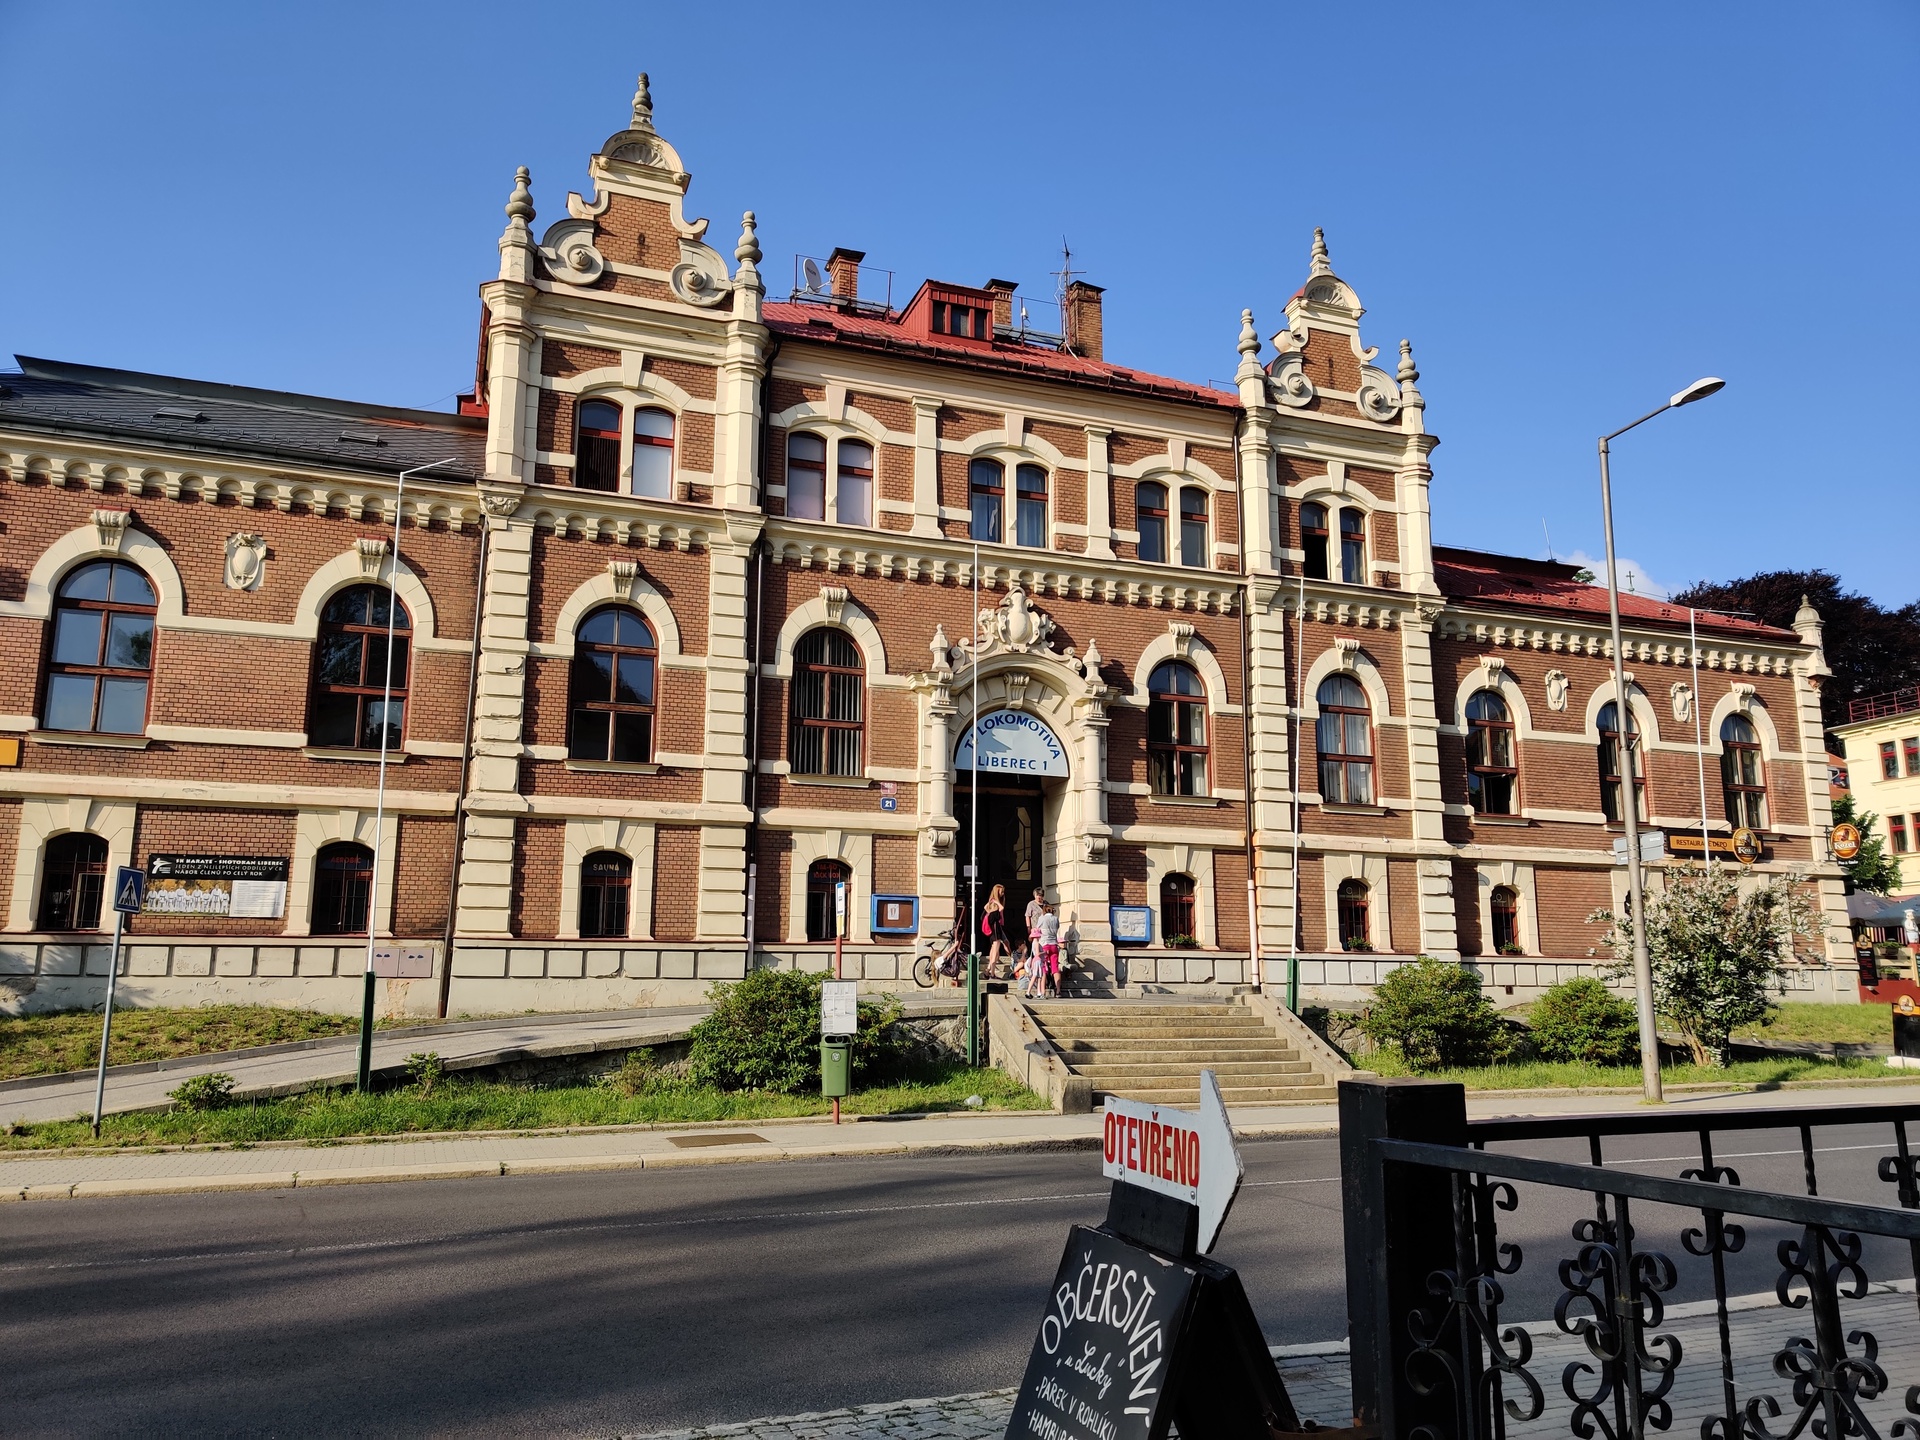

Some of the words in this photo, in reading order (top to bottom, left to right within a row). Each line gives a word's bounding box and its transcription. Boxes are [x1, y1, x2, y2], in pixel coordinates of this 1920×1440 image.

[976, 713, 1061, 760] LOKOMOTIVA
[978, 755, 1037, 770] LIBEREC
[885, 800, 892, 808] 21
[1676, 839, 1711, 847] RESTAURAE
[1834, 842, 1857, 850] Kozel
[592, 863, 620, 872] SAUNA
[1104, 1111, 1200, 1188] OTEVŘENO
[1042, 1250, 1162, 1428] OBČERSTVENÍ
[1037, 1376, 1069, 1412] PÁREK
[1068, 1395, 1078, 1415] V
